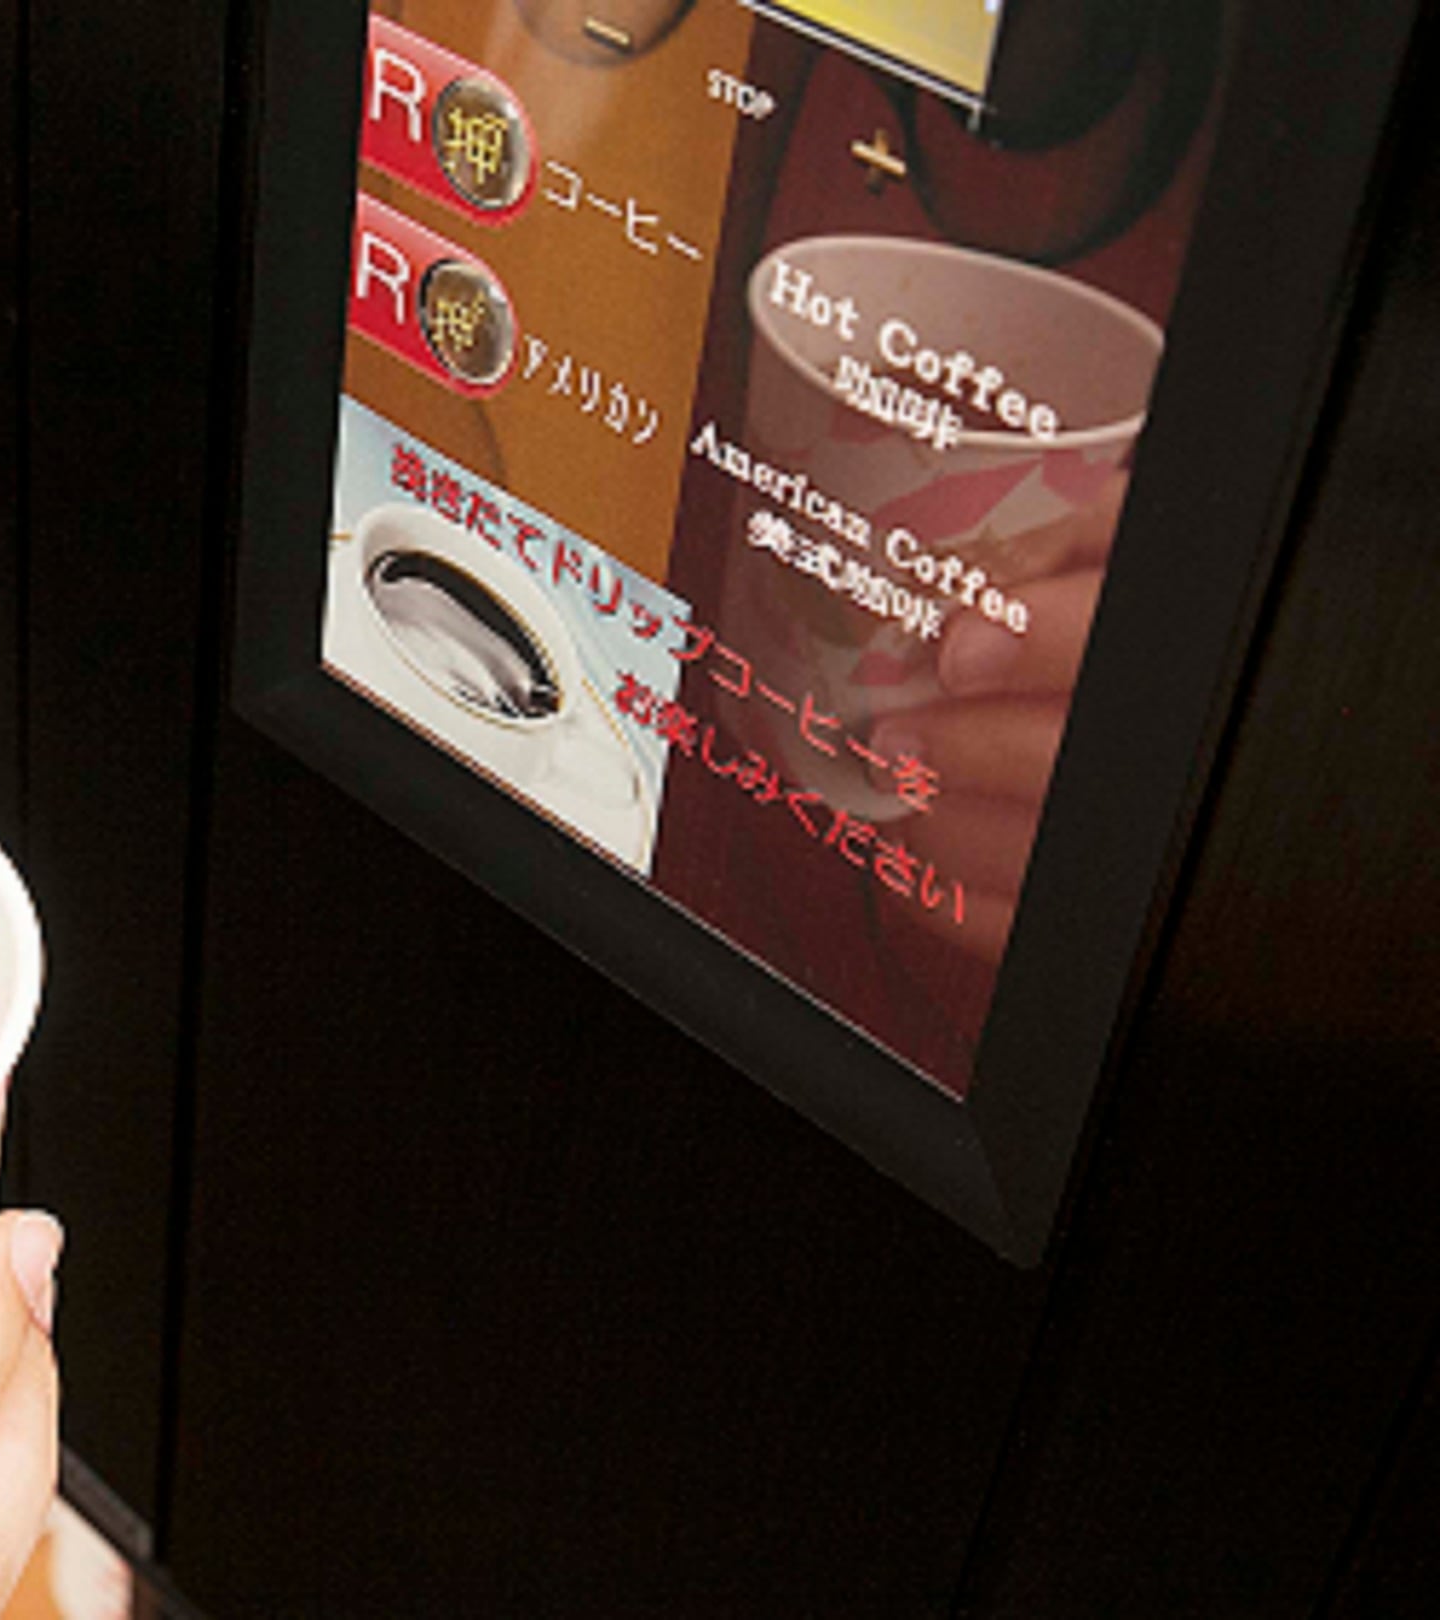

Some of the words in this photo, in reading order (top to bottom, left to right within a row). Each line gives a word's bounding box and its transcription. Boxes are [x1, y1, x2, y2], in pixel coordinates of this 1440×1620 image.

[370, 49, 425, 142] R
[707, 69, 777, 120] STOP
[543, 160, 704, 261] コーヒー
[355, 231, 410, 325] R
[524, 334, 659, 444] アメリカン
[769, 261, 859, 340] Hot
[879, 319, 1059, 440] Coffee
[690, 422, 872, 550] American
[886, 528, 1029, 634] Coffee
[615, 671, 965, 924] お楽しみください
